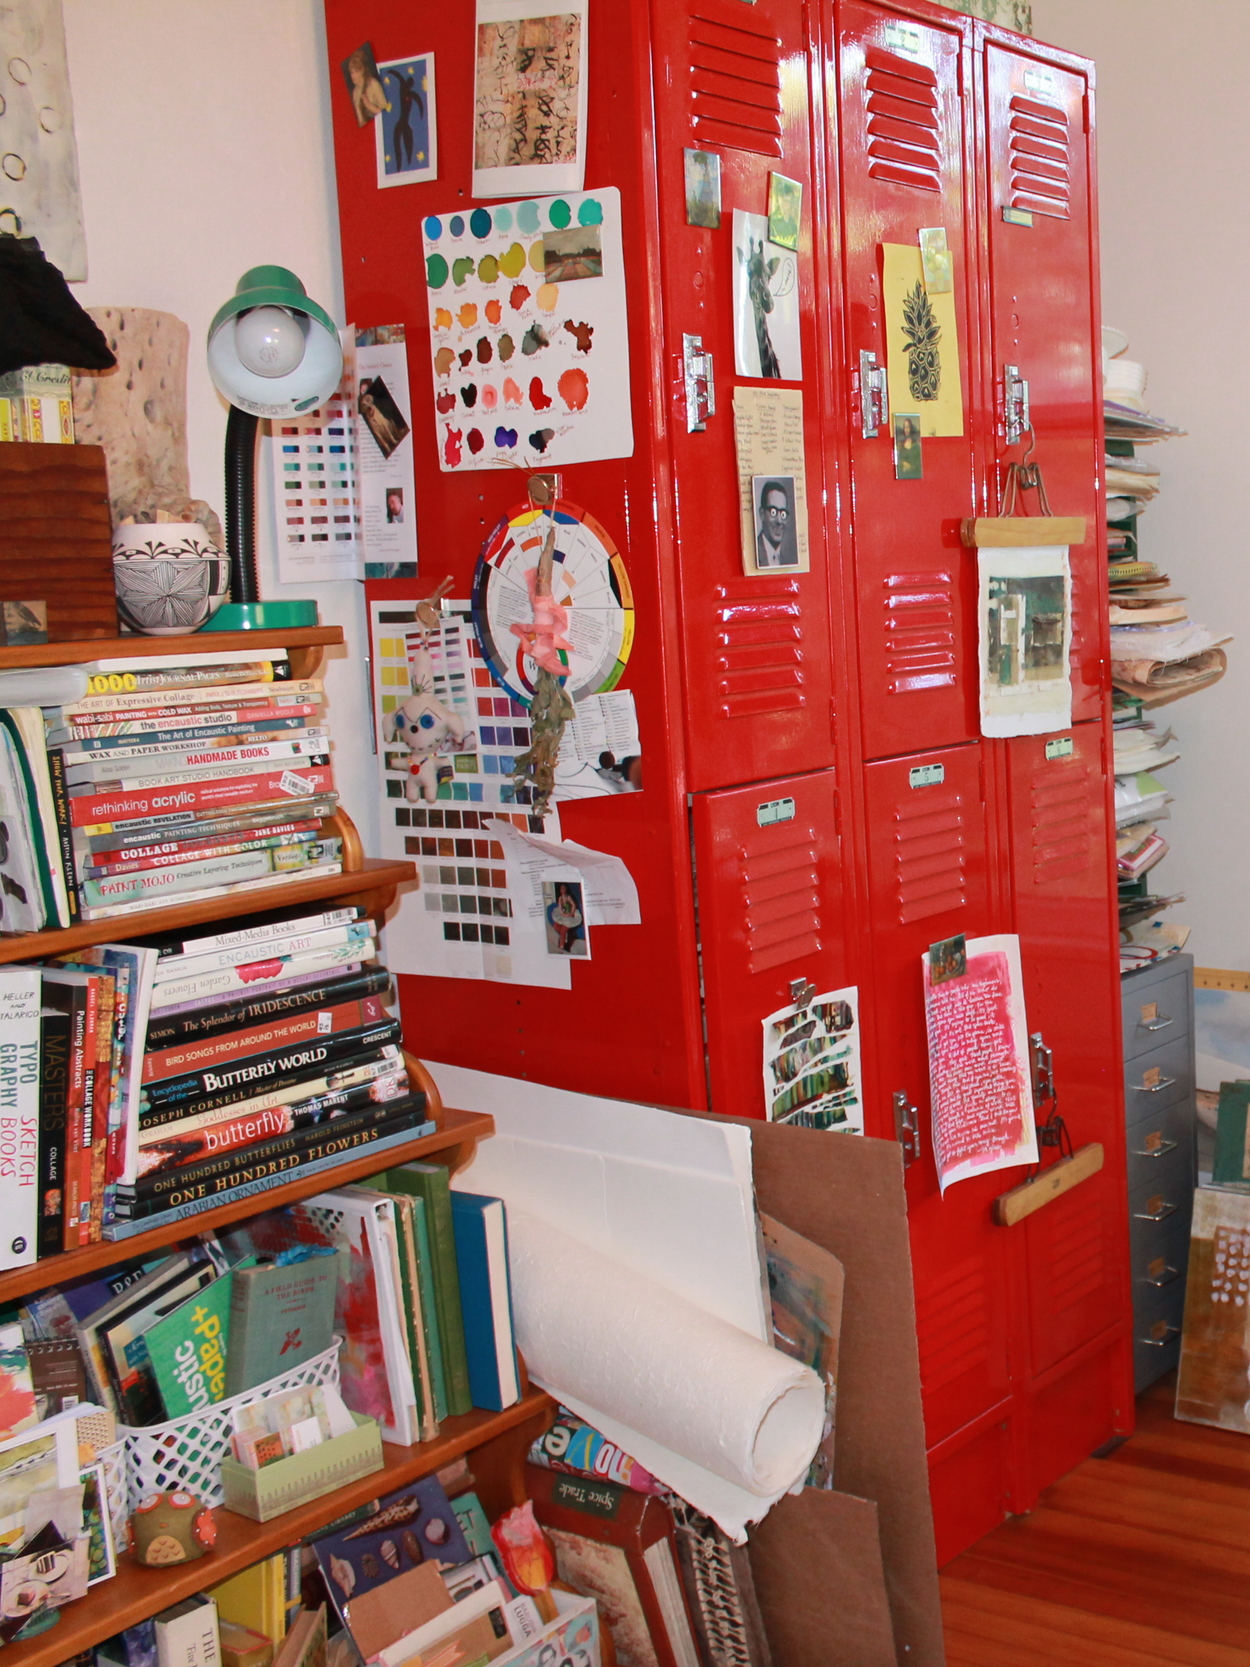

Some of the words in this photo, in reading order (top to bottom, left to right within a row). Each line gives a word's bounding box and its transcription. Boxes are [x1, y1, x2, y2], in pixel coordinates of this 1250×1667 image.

[77, 701, 90, 709] THE
[91, 699, 103, 708] ART
[105, 699, 114, 707] OF
[116, 695, 161, 706] Expressive
[163, 692, 195, 703] Collage
[75, 712, 114, 724] wabi-sabi
[115, 711, 148, 721] PAINTING
[157, 707, 176, 717] COLD
[176, 706, 193, 715] WAX
[140, 721, 156, 730] the
[157, 715, 203, 728] encaustic
[203, 713, 232, 724] studio
[157, 732, 171, 741] The
[173, 731, 184, 740] Art
[185, 730, 193, 738] of
[194, 726, 226, 737] Encaustic
[228, 723, 255, 734] Painting
[89, 751, 111, 760] WAX
[131, 744, 160, 755] PAPER
[162, 741, 207, 752] WORKSHOP
[187, 750, 237, 766] HANDMADE
[240, 747, 270, 759] BOOKS
[52, 756, 63, 777] SHOW
[138, 776, 162, 787] BOOK
[164, 775, 180, 784] ART
[182, 771, 210, 783] STUDIO
[213, 766, 254, 777] HANDBOOK
[54, 778, 65, 798] YOUR
[92, 799, 148, 816] rethinking
[152, 791, 196, 808] acrylic
[115, 819, 152, 829] encaustic
[153, 813, 193, 823] REVELATION
[123, 833, 161, 844] encaustic
[164, 827, 198, 838] PAINTING
[199, 820, 240, 832] TECHNIQUES
[62, 836, 72, 860] AUSTIN
[115, 862, 139, 872] Davies
[153, 850, 200, 866] COLLAGE
[204, 846, 230, 857] WITH
[235, 839, 268, 852] COLOR
[121, 843, 178, 860] COLLAGE
[64, 861, 75, 887] KLEON
[100, 879, 138, 896] PAINT
[140, 873, 175, 889] MOJO
[176, 869, 202, 879] Creative
[203, 864, 229, 875] Layering
[231, 858, 263, 869] Techniques
[215, 926, 270, 946] Mixed-Media
[271, 923, 296, 937] Books
[218, 943, 285, 966] ENCAUSTIC
[289, 936, 312, 951] ART
[163, 982, 197, 997] Flowers
[200, 975, 231, 990] Garden
[4, 991, 35, 1000] HELLER
[0, 1010, 39, 1020] TALARICO
[149, 1027, 176, 1040] SIMON
[183, 1021, 199, 1032] The
[200, 1013, 236, 1030] Splendor
[237, 1007, 246, 1022] of
[247, 988, 327, 1017] IRIDESCENCE
[74, 1010, 85, 1046] Painting
[363, 1030, 392, 1045] CRESCENT
[166, 1055, 185, 1067] BIRD
[186, 1048, 215, 1061] SONGS
[215, 1041, 239, 1054] FROM
[240, 1031, 273, 1047] AROUND
[273, 1027, 289, 1039] THE
[290, 1020, 316, 1034] WORLD
[20, 1040, 38, 1084] TYPO
[73, 1048, 84, 1089] Abstracts
[203, 1060, 277, 1092] BUTTERFLY
[277, 1047, 328, 1067] WORLD
[0, 1043, 18, 1108] GRAPHY
[44, 1035, 67, 1131] MASTERS
[85, 1074, 94, 1104] COLLAGE
[152, 1079, 198, 1097] Encyclopedia
[167, 1094, 176, 1103] of
[176, 1091, 188, 1100] the
[189, 1091, 247, 1114] CORNELL
[196, 1106, 246, 1125] Goddesses
[250, 1102, 258, 1111] in
[262, 1095, 278, 1107] Art
[83, 1105, 93, 1148] WORKBOOK
[205, 1110, 284, 1150] butterfly
[294, 1102, 322, 1116] THOMAS
[322, 1094, 349, 1108] MARENT
[0, 1117, 18, 1178] BOOKS
[19, 1115, 37, 1187] SKETCH
[49, 1146, 57, 1181] COLLAGE
[154, 1178, 176, 1193] ONE
[181, 1160, 231, 1184] HUNDRED
[234, 1139, 296, 1166] BUTTERFLIES
[305, 1127, 331, 1141] HAROLD
[170, 1184, 206, 1206] ONE
[215, 1155, 300, 1191] HUNDRED
[308, 1128, 379, 1161] FLOWERS
[176, 1195, 228, 1220] ARABIAN
[228, 1172, 294, 1203] ORNAMENT
[271, 1283, 292, 1294] FIELD
[294, 1277, 315, 1288] GUIDE
[318, 1274, 328, 1282] TO
[276, 1292, 290, 1300] THE
[292, 1286, 314, 1297] BIRDS
[558, 1483, 586, 1505] Trade
[588, 1491, 615, 1510] Spice
[202, 1628, 216, 1663] THE
